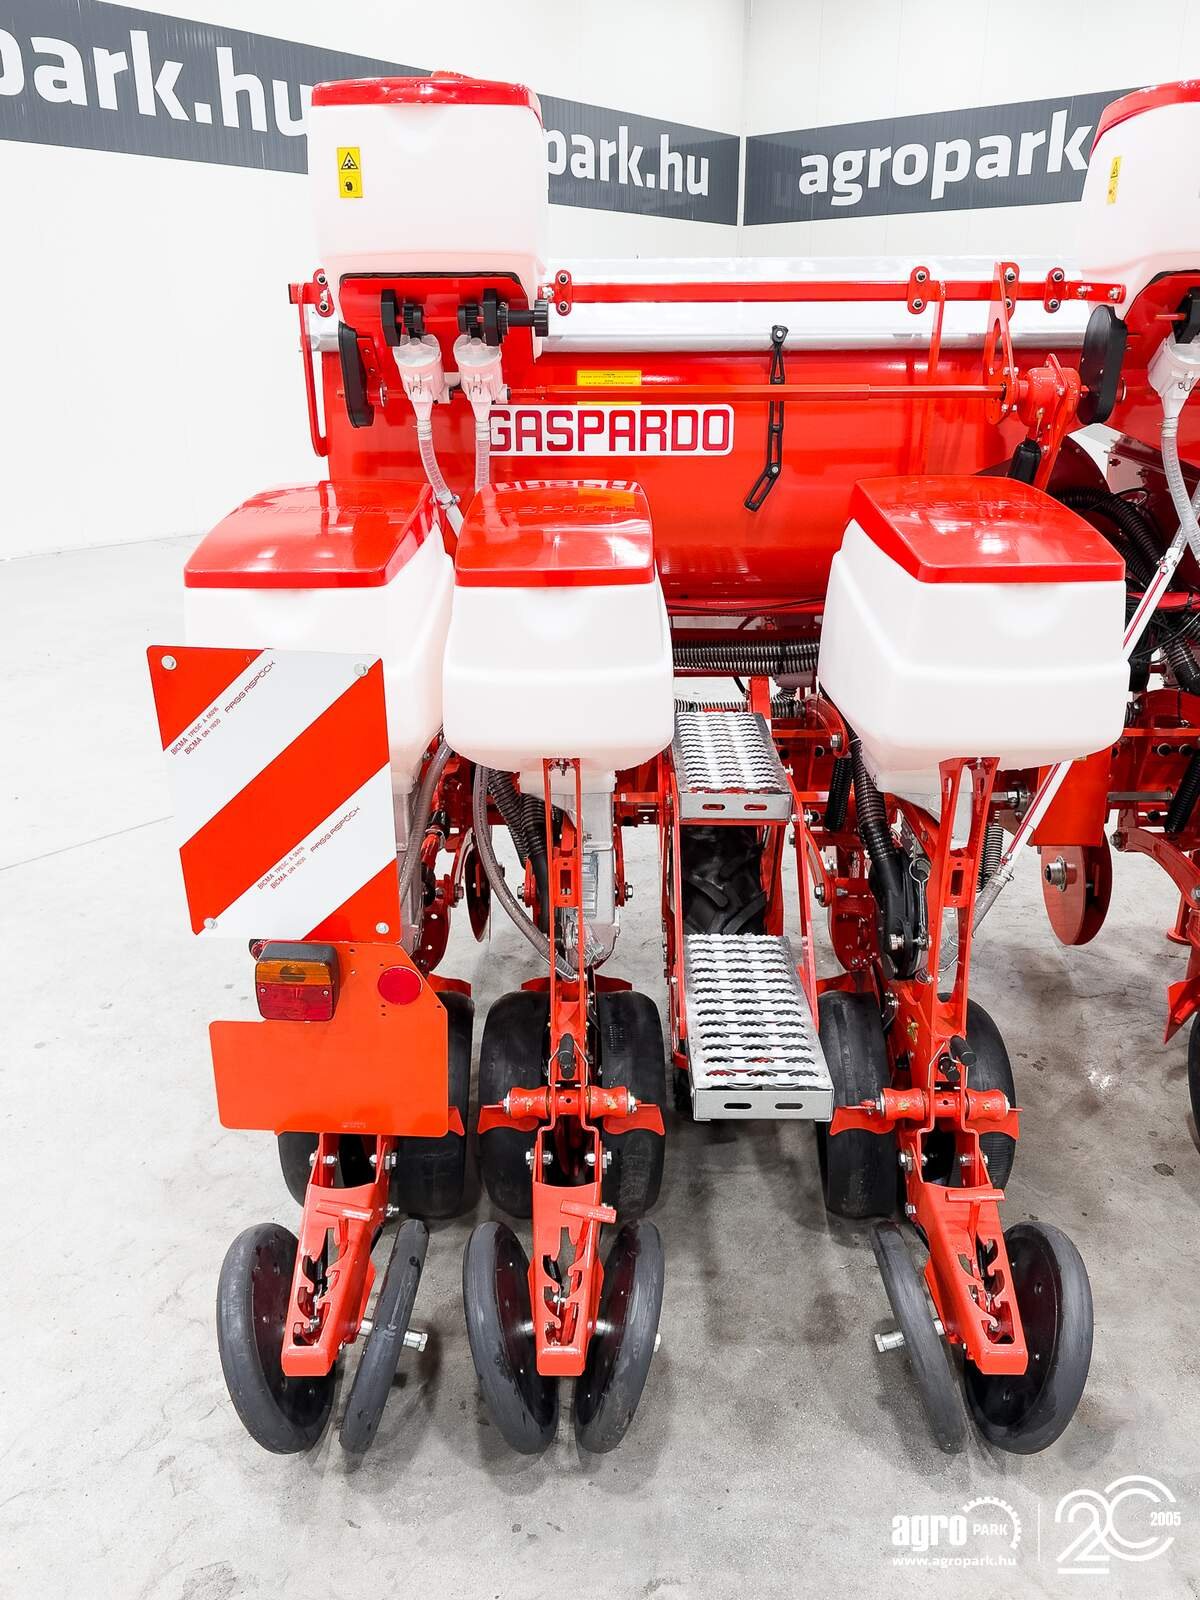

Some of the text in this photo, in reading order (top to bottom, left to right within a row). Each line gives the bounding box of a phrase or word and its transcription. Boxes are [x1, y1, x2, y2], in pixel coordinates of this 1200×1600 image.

[799, 109, 1093, 206] agropark
[490, 410, 730, 452] GASPARDO
[170, 737, 188, 755] BICMA
[184, 737, 202, 755] BICMA
[257, 873, 275, 890] BICMA
[270, 873, 288, 889] BICMA
